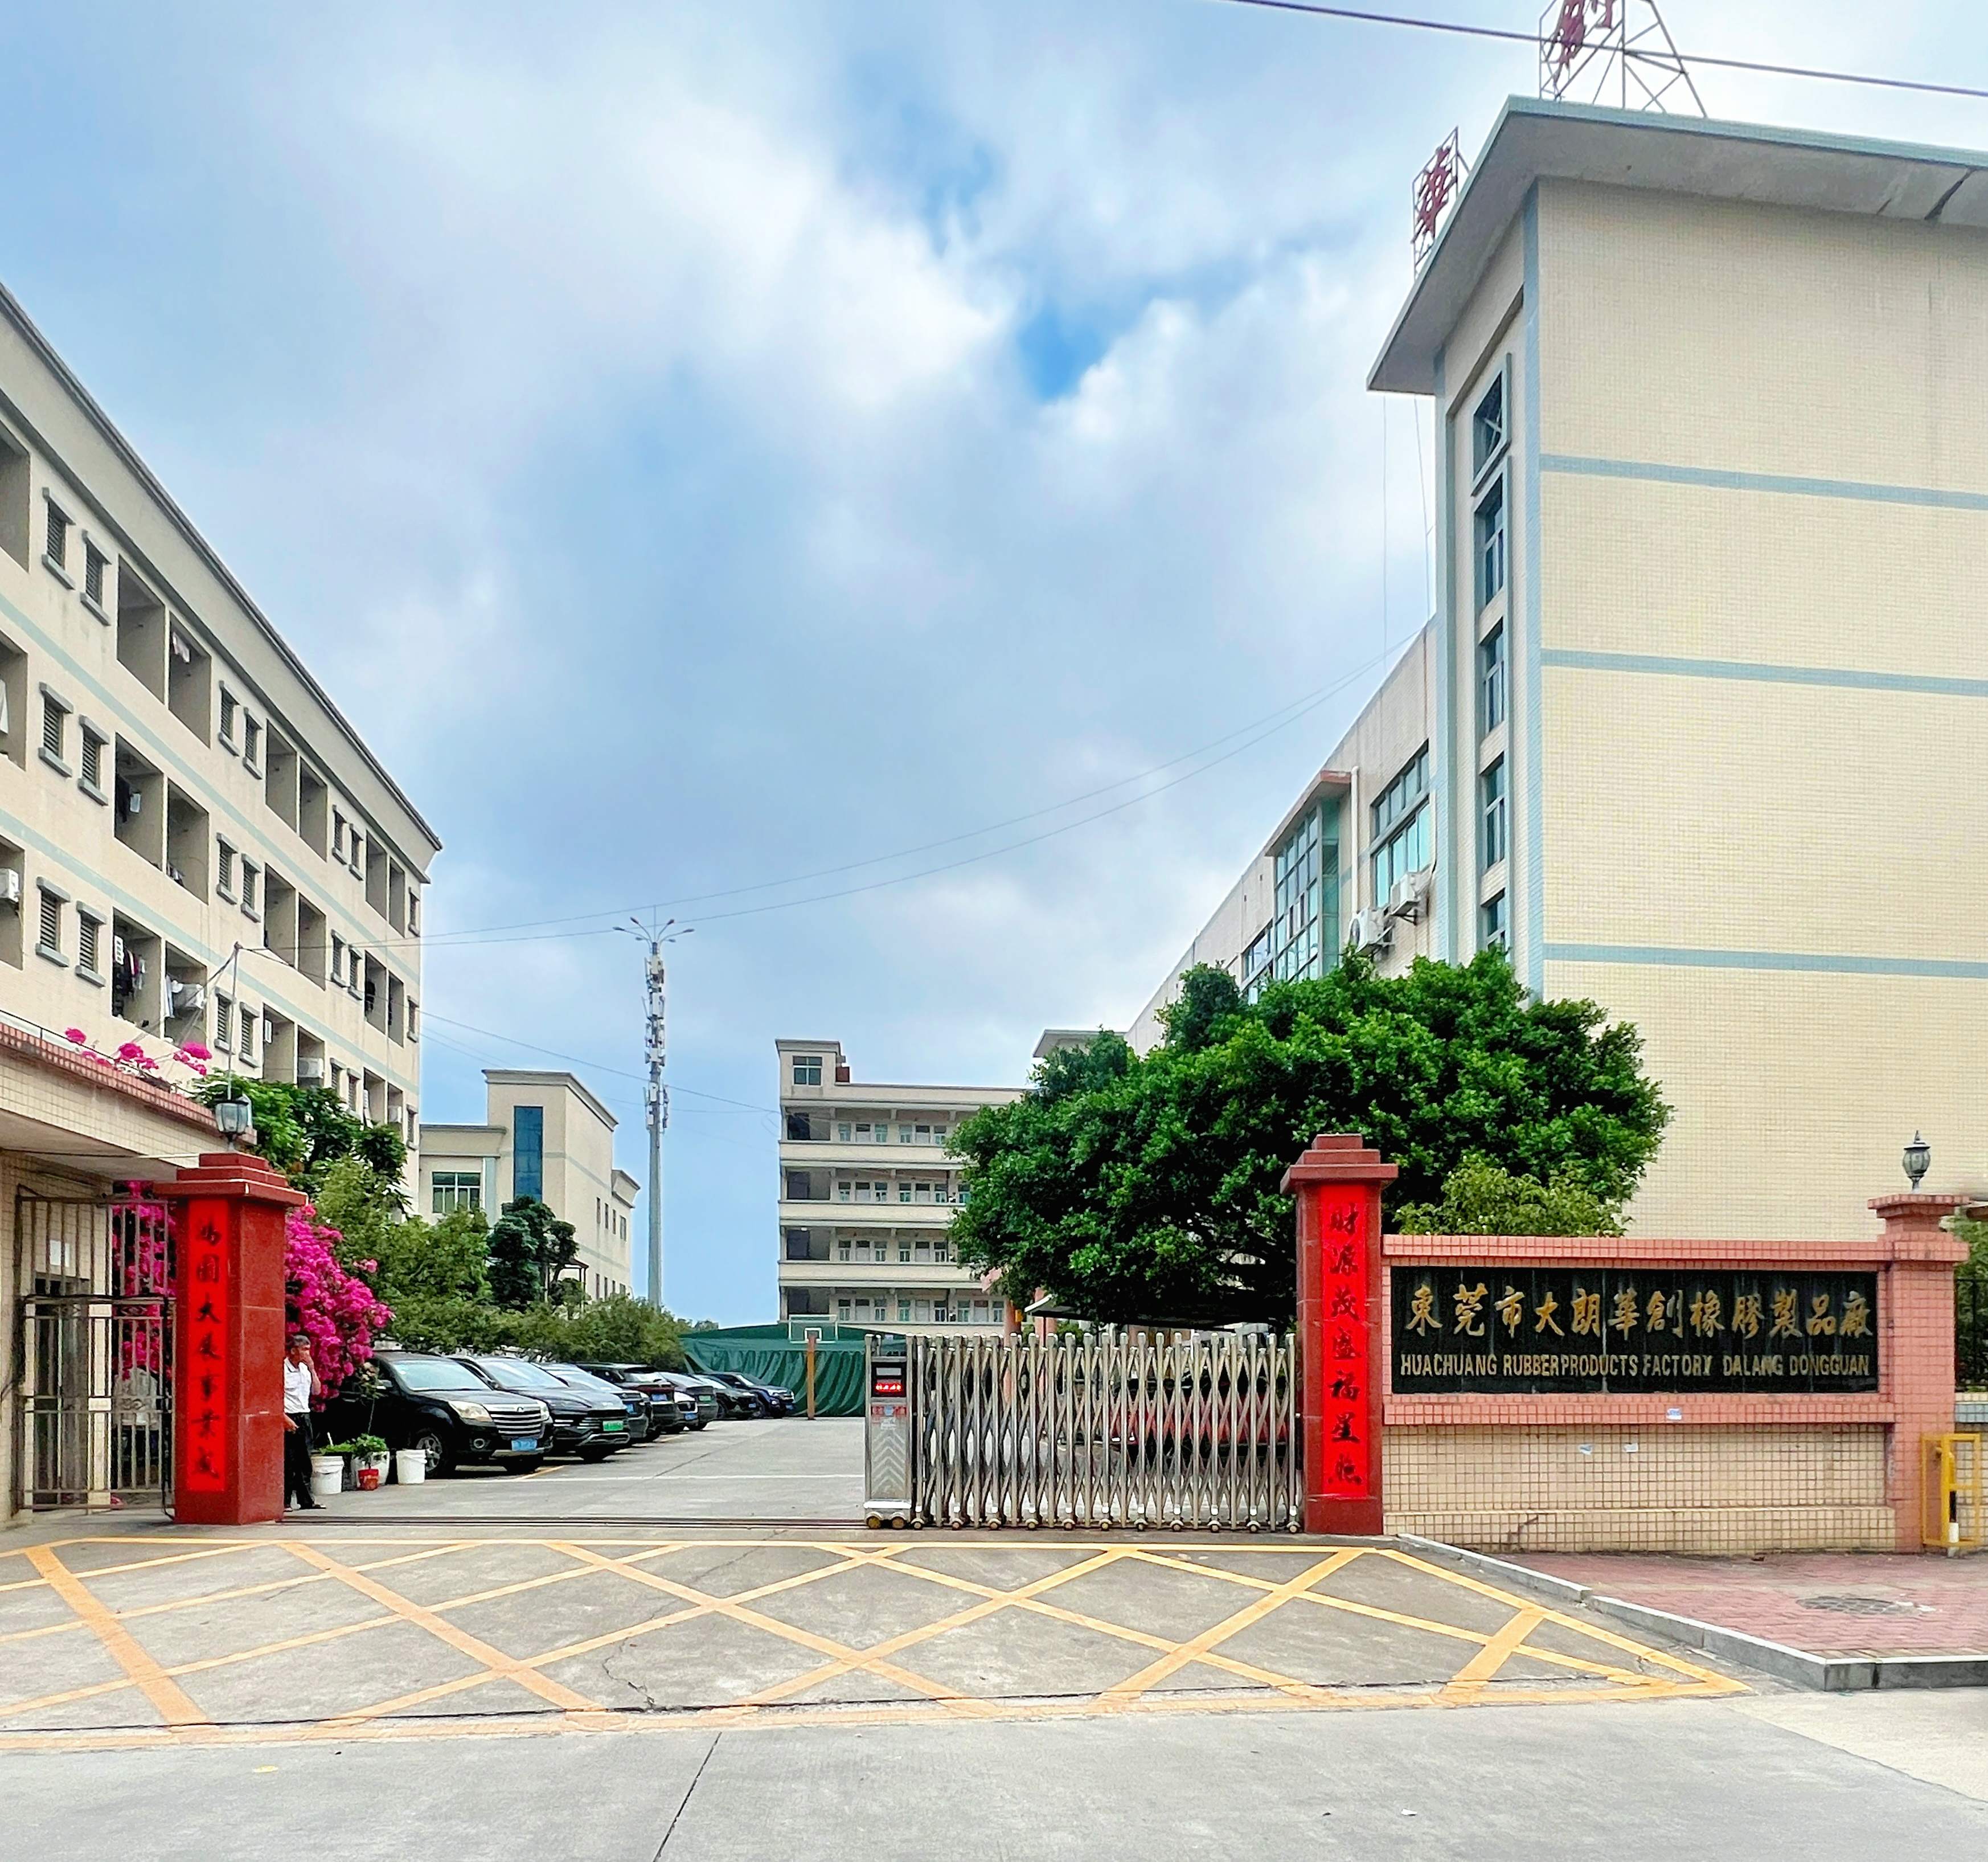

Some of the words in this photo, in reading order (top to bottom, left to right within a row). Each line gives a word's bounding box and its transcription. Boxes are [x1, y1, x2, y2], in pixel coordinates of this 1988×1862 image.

[1400, 1353, 1498, 1377] HUACHUANG
[1503, 1353, 1559, 1377] RUBBER
[1560, 1354, 1638, 1377] PRODUCTS
[1642, 1354, 1713, 1377] FACTORY
[1722, 1354, 1784, 1377] DALANG
[1789, 1354, 1870, 1376] DONGGUAN
